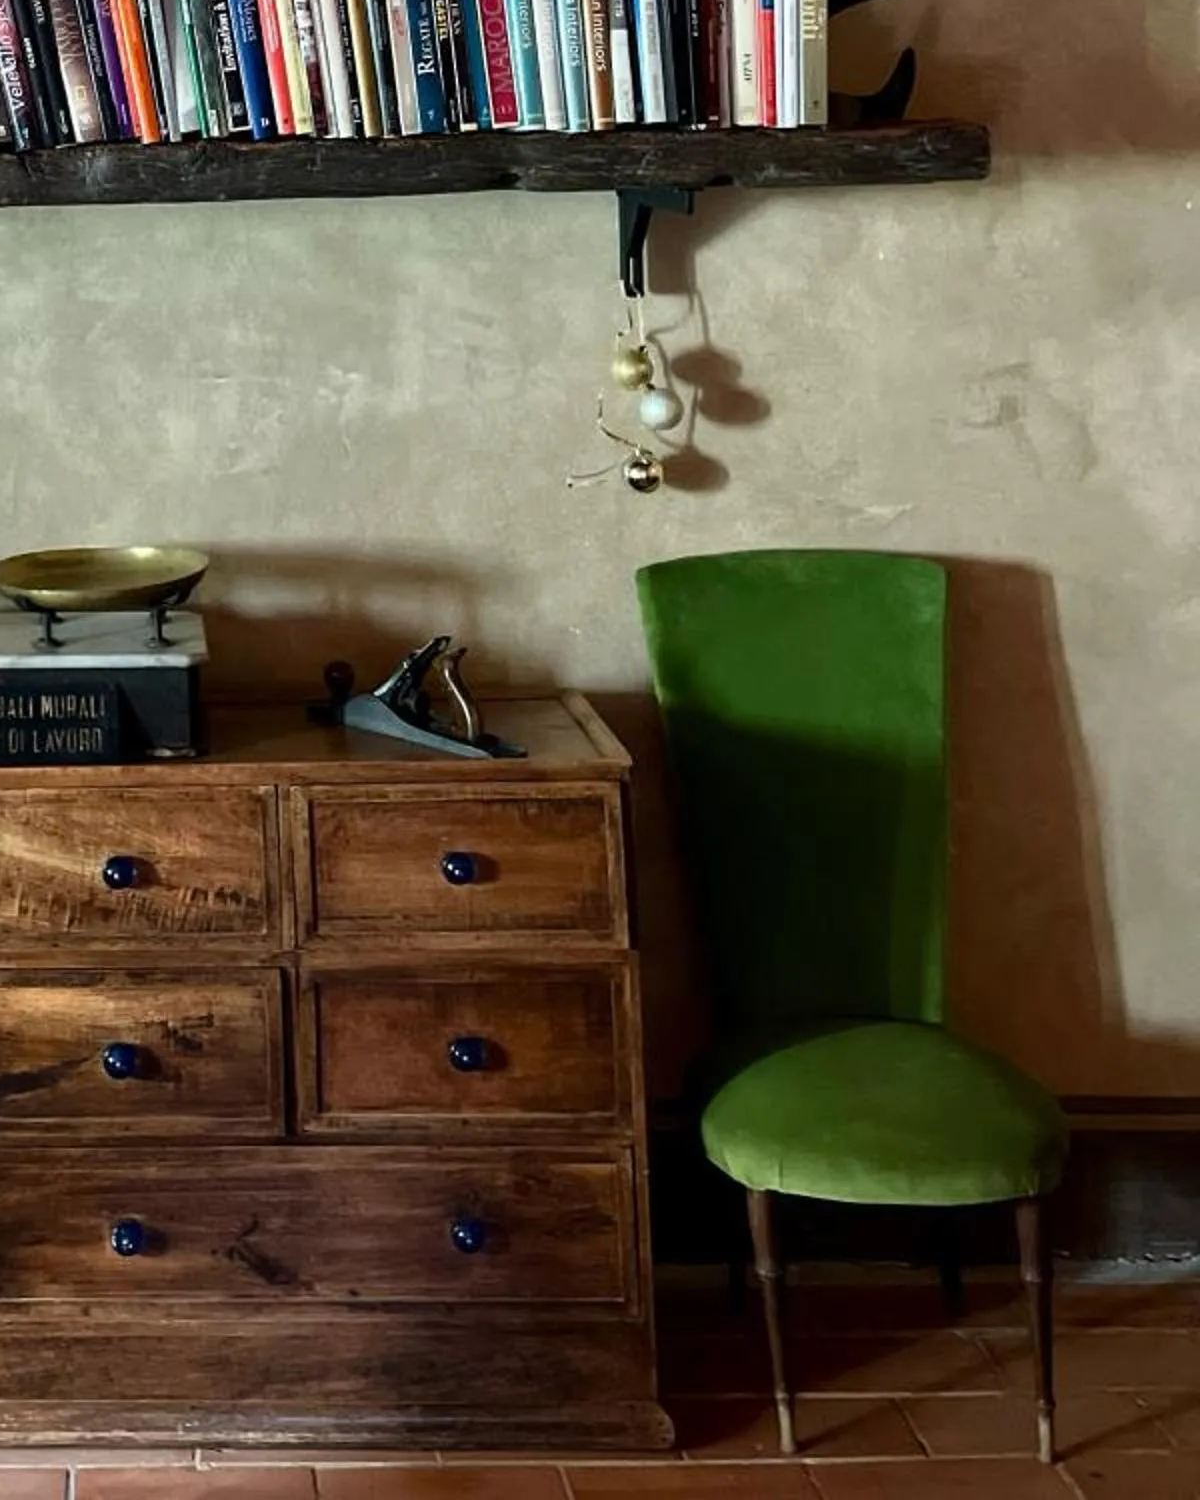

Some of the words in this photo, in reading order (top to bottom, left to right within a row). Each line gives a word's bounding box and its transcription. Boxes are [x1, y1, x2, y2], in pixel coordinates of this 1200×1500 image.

[214, 12, 238, 72] Invitation
[413, 17, 435, 75] REGATE
[435, 0, 449, 41] GASTEL
[565, 6, 583, 67] Interiors
[591, 13, 609, 72] Interiors
[40, 694, 106, 720] MURALI
[8, 727, 26, 754] DI
[33, 727, 102, 754] LAVORO
